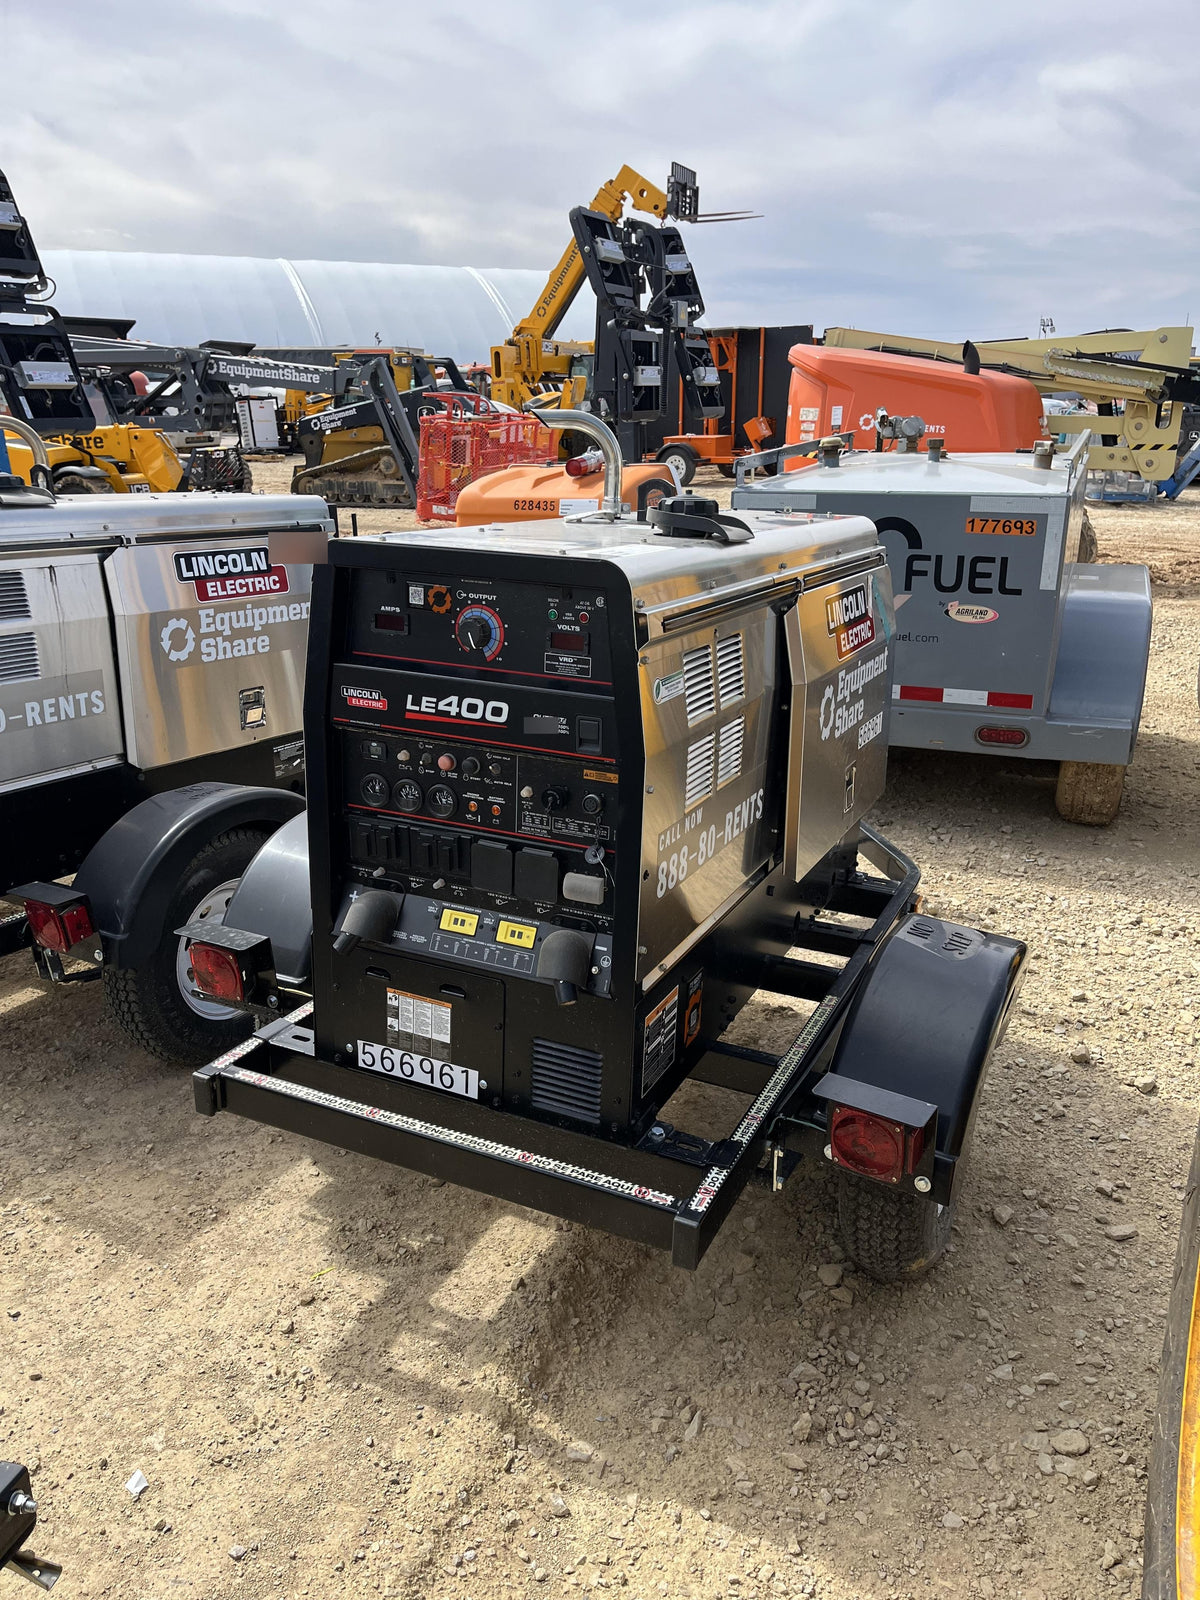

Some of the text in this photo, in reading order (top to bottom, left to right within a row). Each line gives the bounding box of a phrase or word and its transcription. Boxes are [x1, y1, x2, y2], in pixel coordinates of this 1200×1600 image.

[218, 361, 320, 384] EquipmentShare
[319, 408, 358, 422] Equipment
[321, 418, 342, 430] Share
[924, 425, 946, 434] ENTS
[513, 500, 556, 512] 628435
[966, 518, 1035, 535] 177693
[179, 550, 268, 578] LINCOLN
[904, 554, 1023, 596] FUEL
[206, 576, 281, 598] ELECTRIC
[199, 601, 310, 635] Equipmen
[828, 590, 866, 630] LINCOLN
[956, 608, 988, 616] AGRILAND
[200, 635, 271, 663] Share
[840, 620, 872, 653] ELECTRIC
[894, 631, 938, 643] uel.com
[836, 646, 889, 703] Equipment
[343, 688, 379, 700] LINCOLN
[352, 698, 384, 708] ELECTRIC
[406, 694, 510, 724] LE400
[834, 698, 865, 739] Share
[656, 788, 765, 900] 888-80-RENTS
[659, 808, 704, 852] CALL NOW
[362, 1042, 469, 1095] 566961
[708, 1176, 720, 1187] DO
[740, 1122, 755, 1139] HERE
[760, 1094, 770, 1108] PAS
[768, 1078, 782, 1098] TENEZ
[780, 1057, 796, 1080] DEBOUT
[282, 1085, 302, 1094] NOT
[304, 1091, 337, 1104] STAND
[338, 1101, 367, 1112] HERE
[396, 1118, 417, 1127] PAS
[418, 1123, 454, 1138] TENEZ
[454, 1135, 501, 1152] DEBOUT
[532, 1158, 551, 1166] NO
[553, 1163, 569, 1172] SE
[570, 1168, 604, 1182] PARE
[603, 1180, 633, 1192] AQUI
